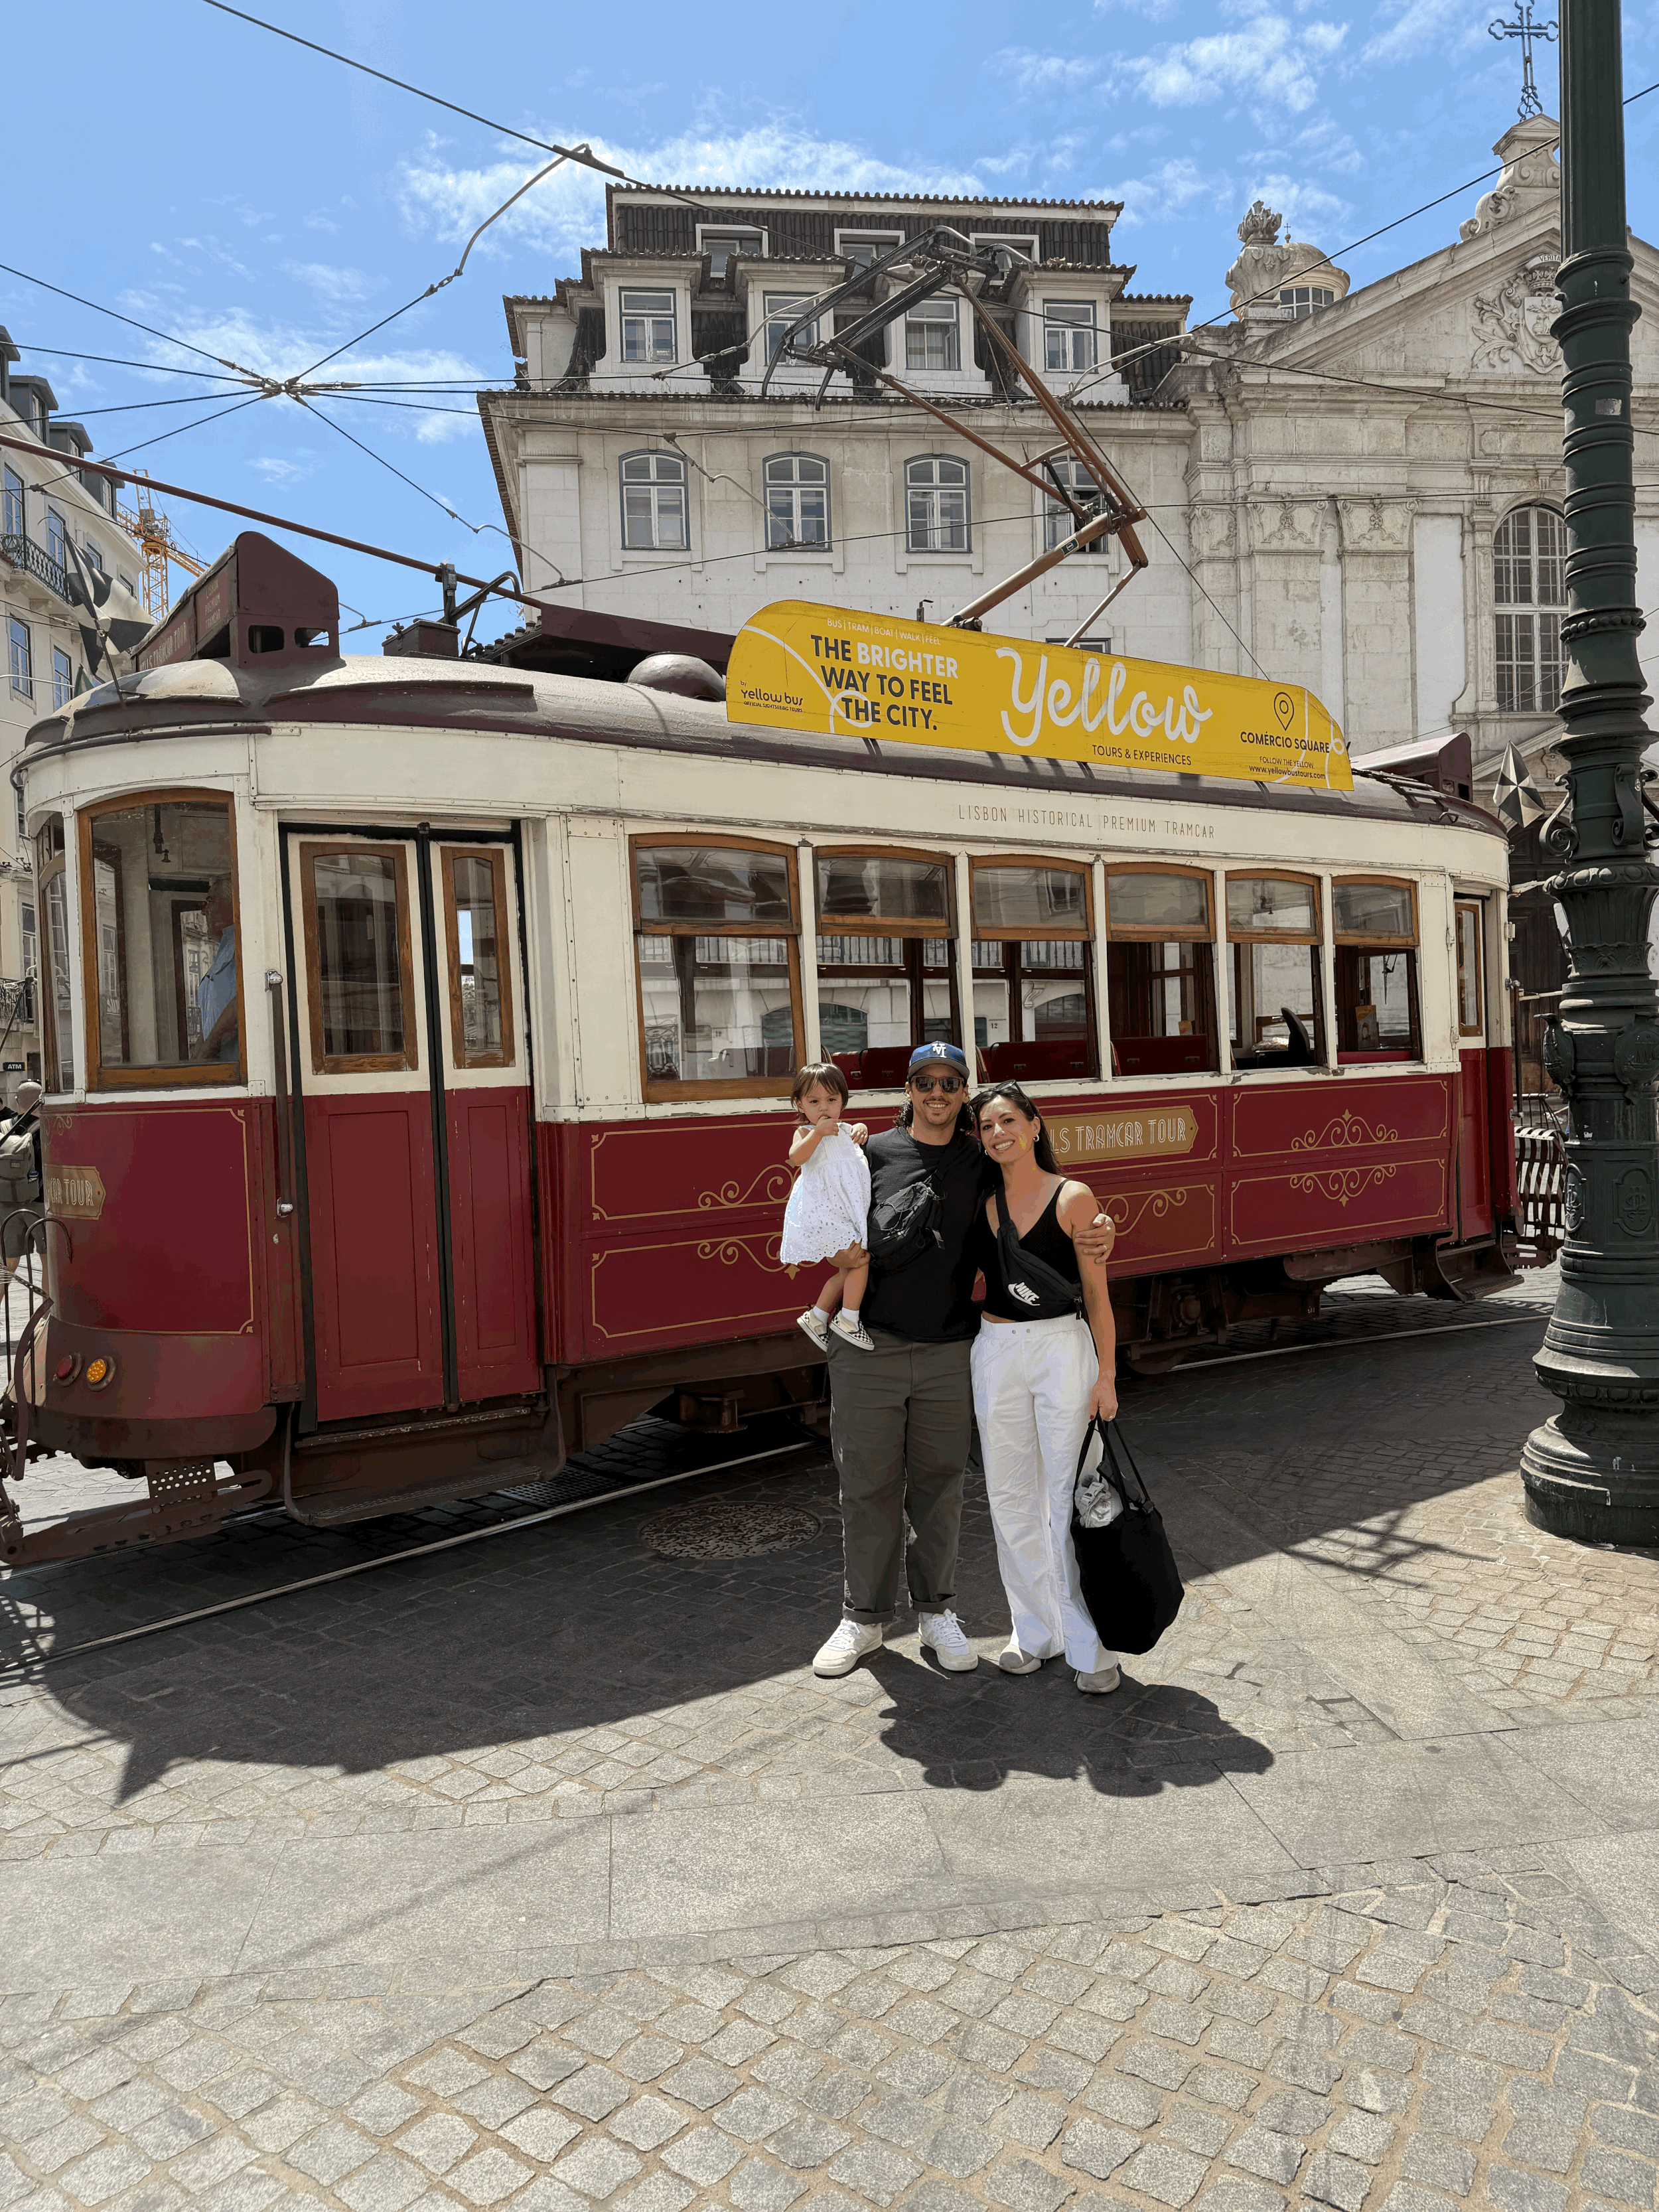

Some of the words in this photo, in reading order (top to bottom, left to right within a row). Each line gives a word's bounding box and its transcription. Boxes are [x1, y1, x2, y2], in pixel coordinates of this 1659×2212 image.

[1540, 254, 1561, 262] VERITA
[827, 618, 842, 628] BUS
[847, 622, 869, 633] TRAM
[875, 627, 893, 637] BOAT
[899, 630, 920, 642] WALK
[926, 635, 941, 645] FEEL
[810, 634, 852, 662] THE
[857, 642, 959, 679] BRIGHTER
[820, 665, 871, 693] WAY
[876, 674, 904, 698] TO
[910, 678, 953, 705] FEEL
[995, 646, 1213, 747] Yellow
[784, 692, 803, 706] bus
[841, 697, 881, 723] THE
[887, 703, 937, 731] CITY.
[1092, 745, 1122, 759] TOURS
[1124, 749, 1132, 759] &
[1133, 749, 1192, 766] EXPERIENCES
[1240, 731, 1292, 749] COMÉRCIO
[1294, 738, 1330, 753] SQUARE
[1249, 765, 1326, 780] www.yellowbustours.com
[1260, 756, 1282, 765] FOLLOW
[958, 804, 1007, 822] LISBON
[1018, 808, 1092, 828] HISTORICAL
[1103, 815, 1156, 833] PREMIUM
[1165, 820, 1215, 840] TRAMCAR
[1050, 1128, 1070, 1153] LS
[1075, 1122, 1143, 1151] TRAMCAR
[1148, 1118, 1187, 1143] TOUR
[64, 1179, 94, 1206] TOUR
[1015, 1282, 1040, 1303] NIKE
